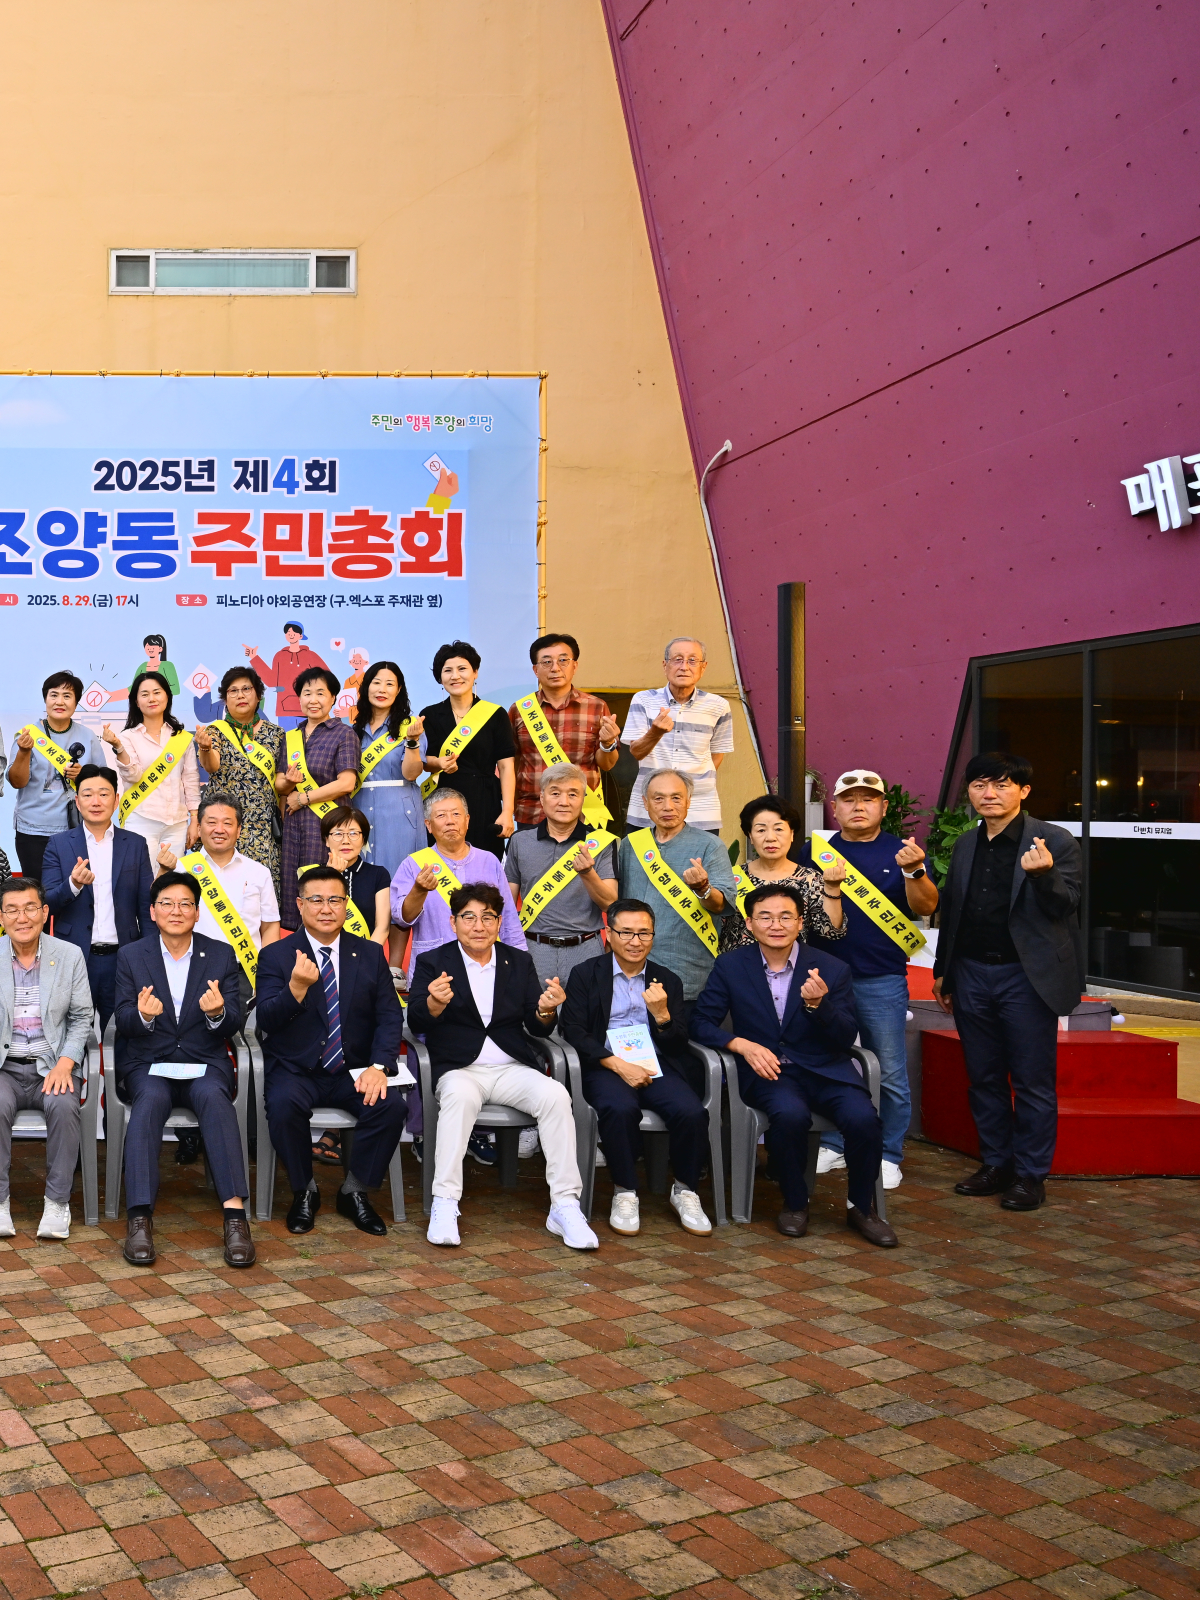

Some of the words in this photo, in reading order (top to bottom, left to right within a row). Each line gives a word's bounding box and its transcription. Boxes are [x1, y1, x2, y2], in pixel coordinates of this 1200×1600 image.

[371, 414, 402, 431] 주민의
[405, 414, 430, 431] 행복
[434, 415, 465, 432] 조양의
[468, 415, 492, 432] 희망
[93, 458, 216, 493] 2025년
[232, 457, 338, 495] 제4회
[189, 507, 464, 580] 주민총회
[115, 593, 139, 607] 17시
[216, 594, 264, 608] 피노디아
[266, 594, 327, 608] 야외공연장
[388, 594, 424, 608] 주재관
[427, 593, 443, 609] 옆)
[842, 872, 920, 950] 양동주민자치회
